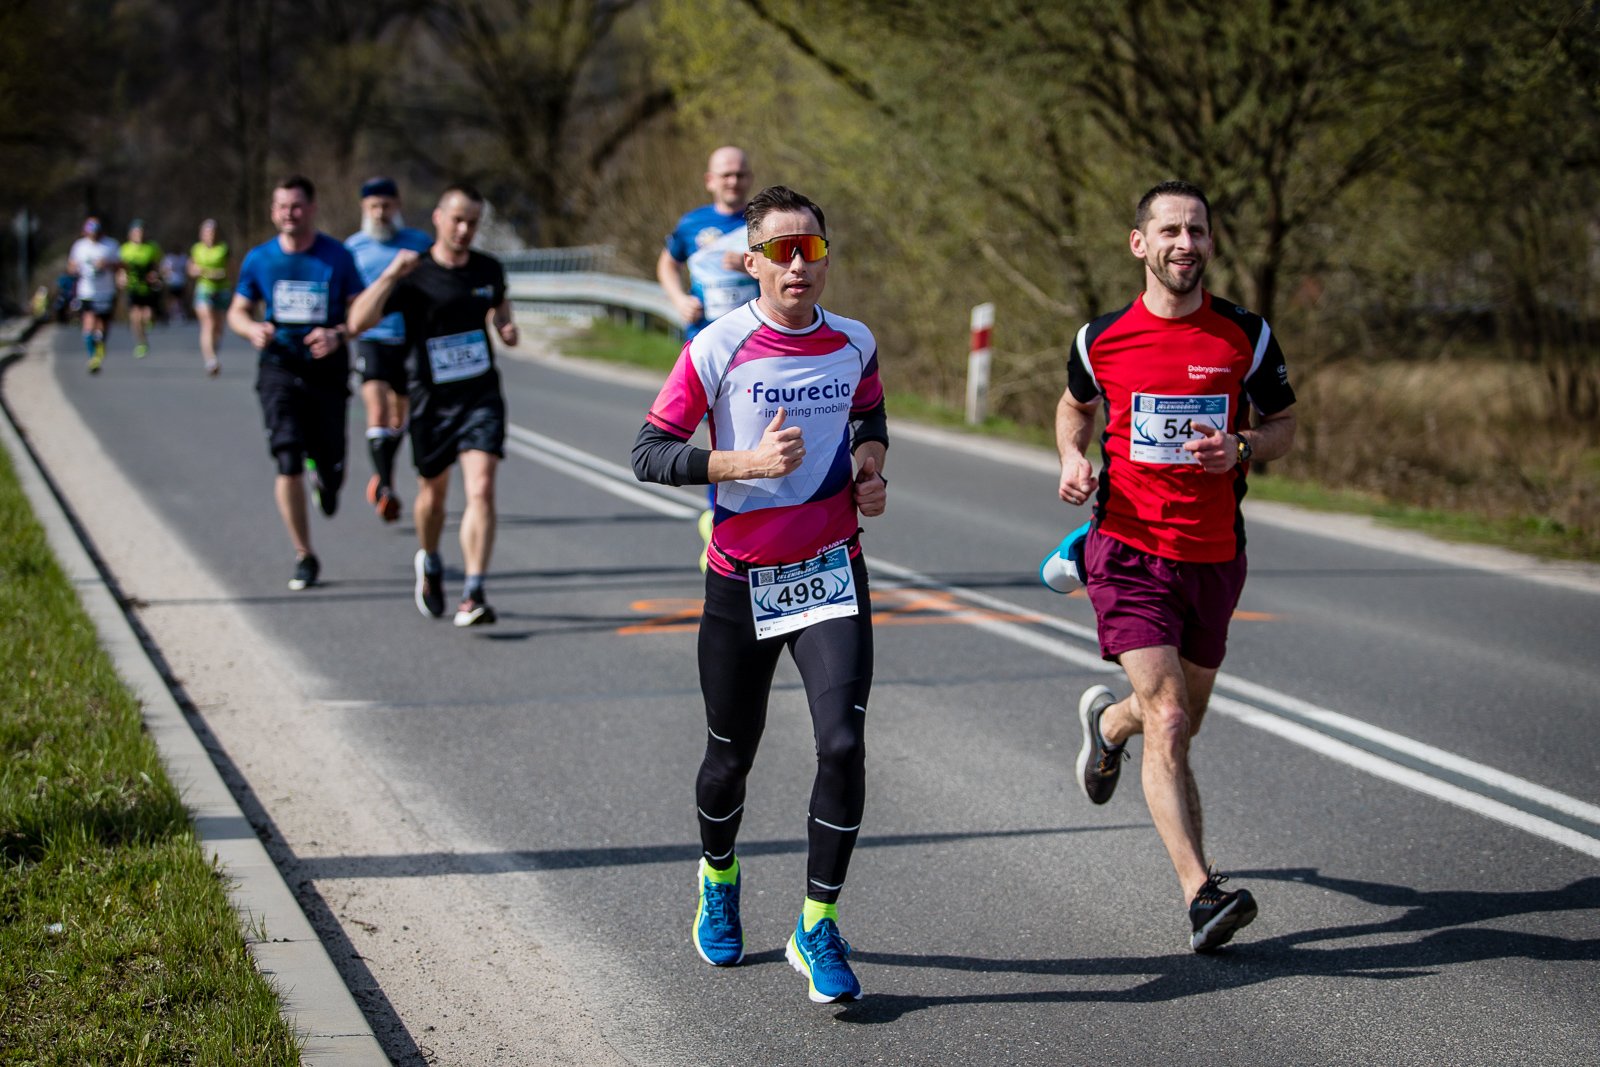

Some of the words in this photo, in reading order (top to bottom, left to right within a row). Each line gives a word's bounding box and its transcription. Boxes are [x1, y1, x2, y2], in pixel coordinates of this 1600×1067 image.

[752, 378, 851, 403] faurecia
[1163, 418, 1194, 439] 54
[777, 577, 827, 607] 498
